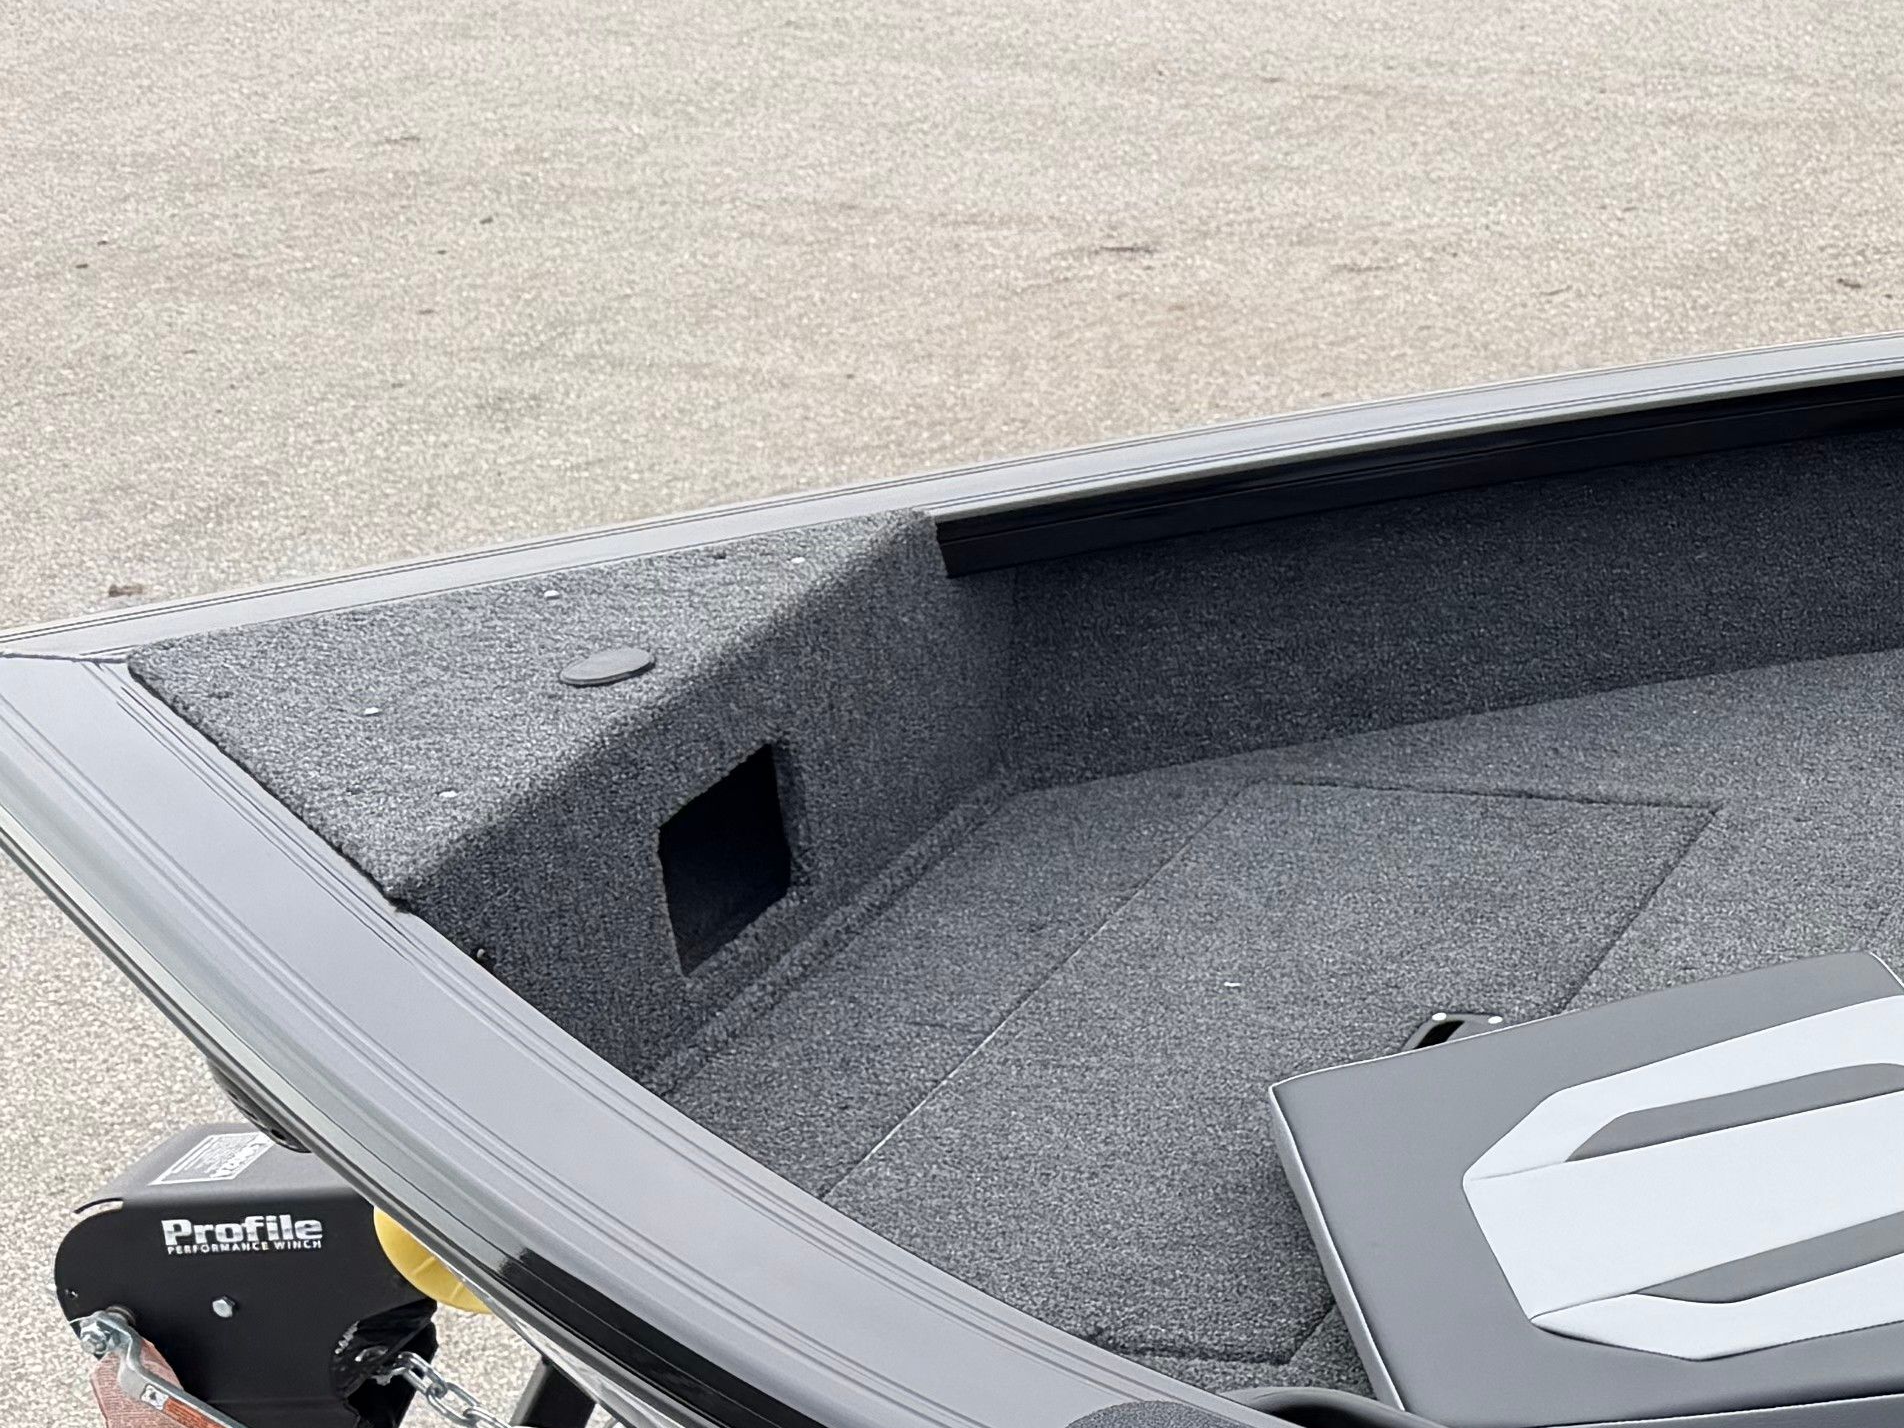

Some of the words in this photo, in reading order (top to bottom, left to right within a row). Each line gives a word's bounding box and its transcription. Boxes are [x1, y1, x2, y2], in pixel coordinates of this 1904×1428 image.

[161, 1214, 323, 1246] Profile
[167, 1242, 269, 1255] PERFORMANCE
[274, 1240, 322, 1250] WINCH
